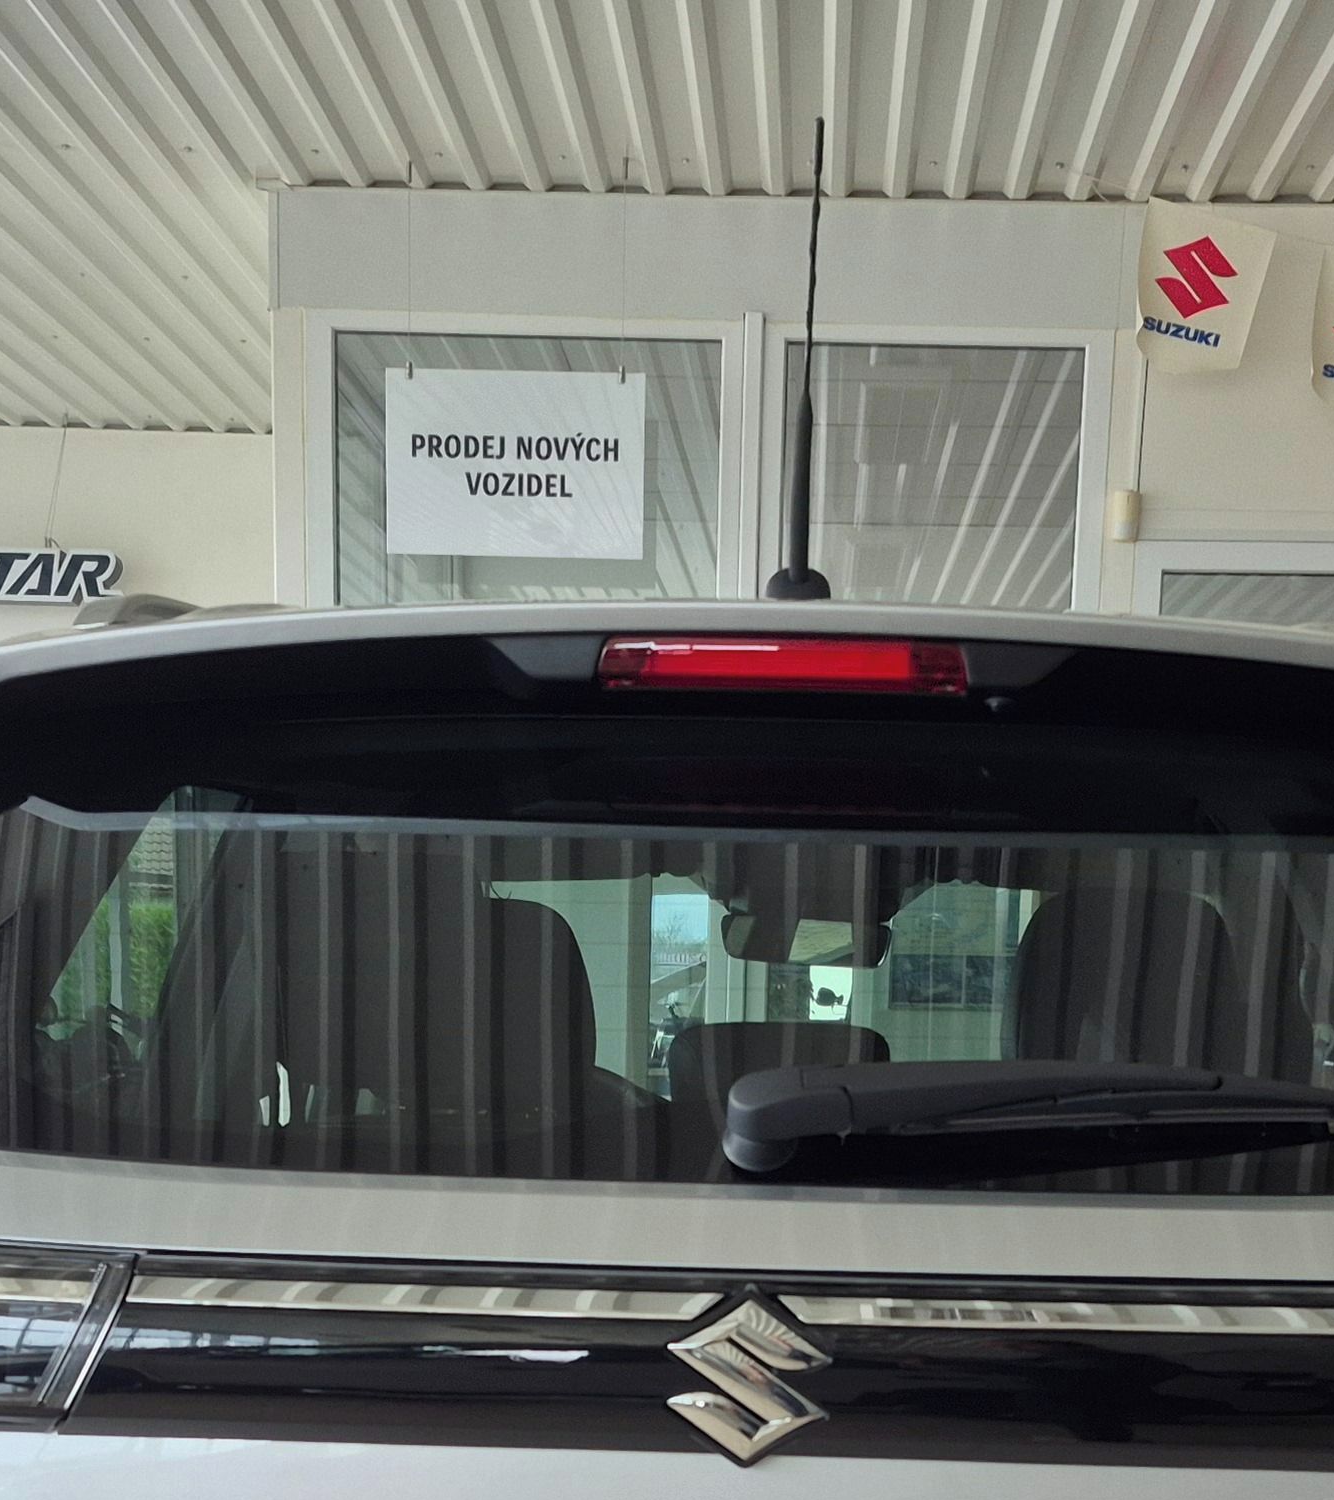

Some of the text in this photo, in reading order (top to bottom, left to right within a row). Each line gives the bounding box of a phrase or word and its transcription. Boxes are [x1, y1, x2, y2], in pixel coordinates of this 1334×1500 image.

[1141, 316, 1221, 348] SUZUKI
[411, 431, 620, 463] PRODEJ NOVÝCH
[465, 471, 573, 499] VOZIDEL
